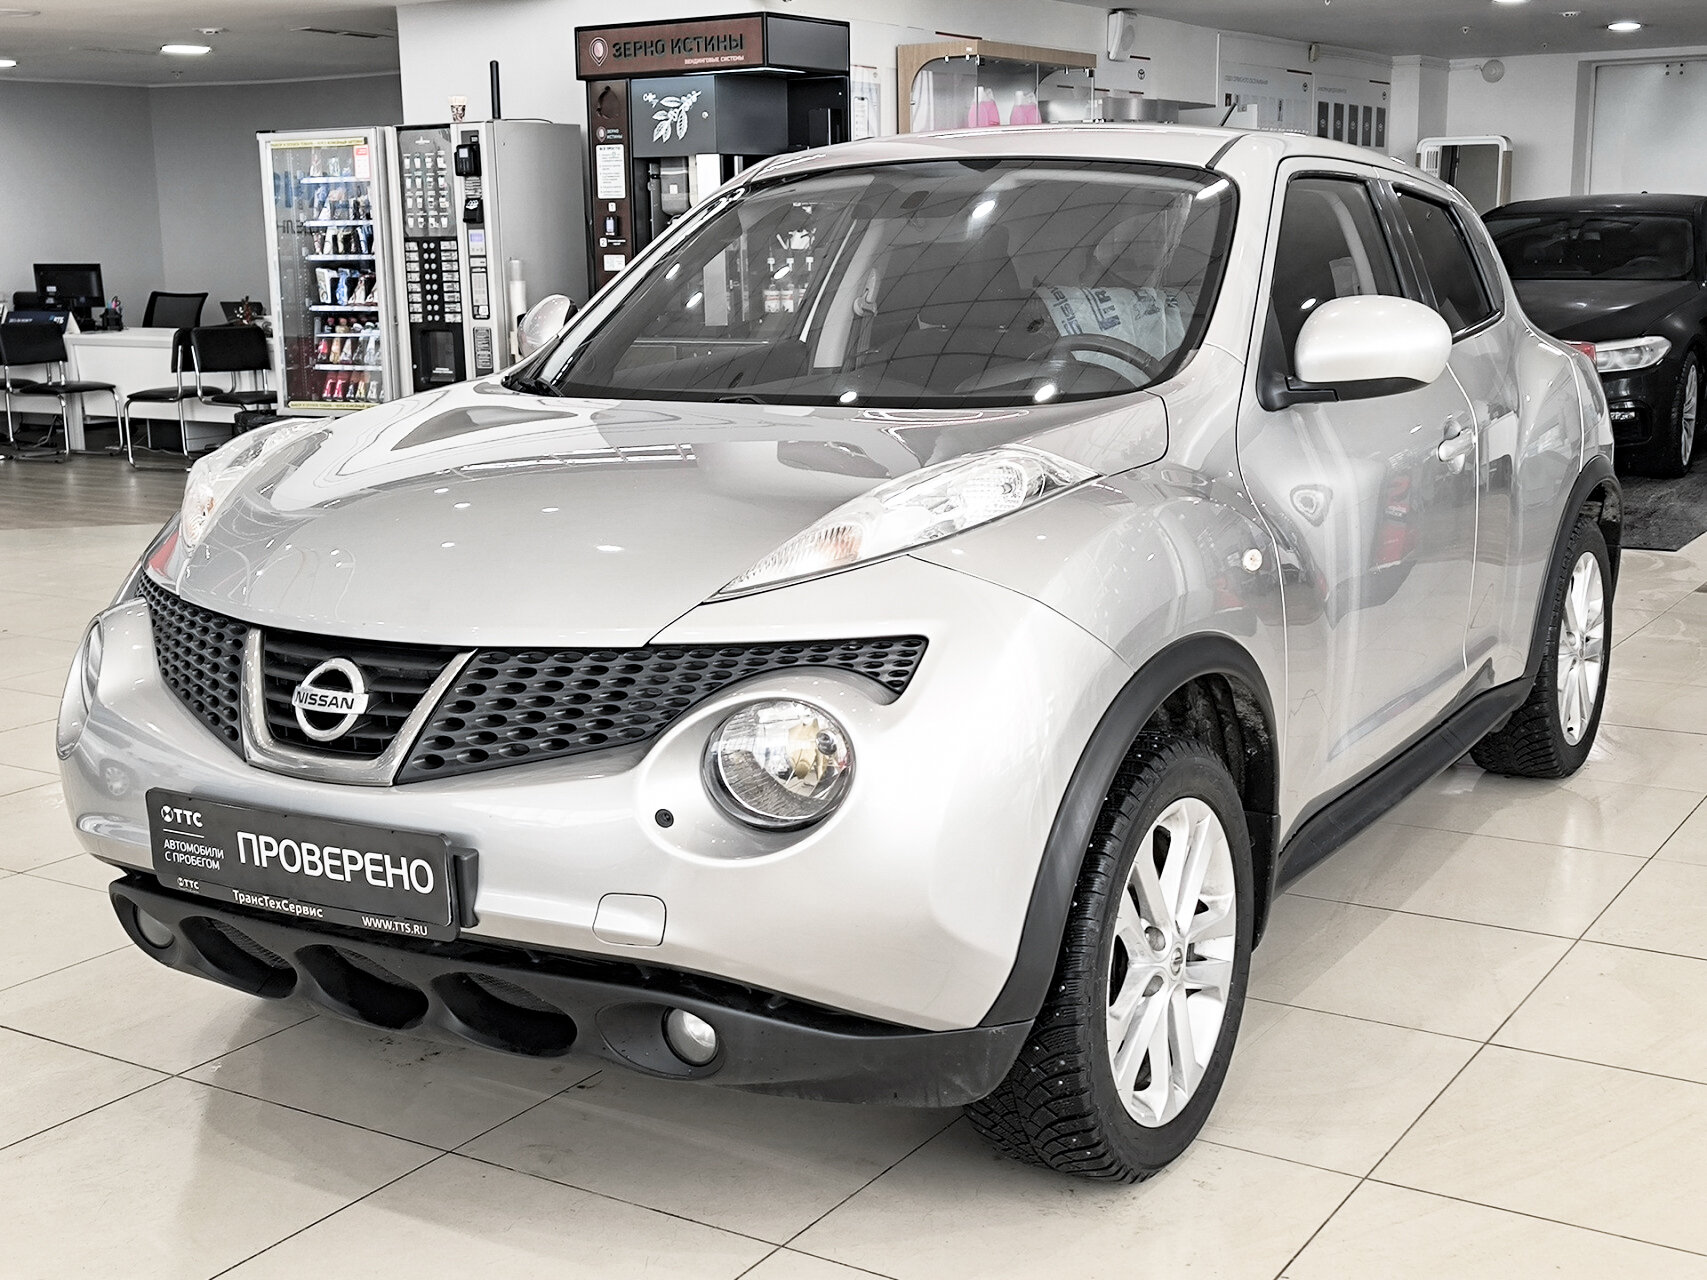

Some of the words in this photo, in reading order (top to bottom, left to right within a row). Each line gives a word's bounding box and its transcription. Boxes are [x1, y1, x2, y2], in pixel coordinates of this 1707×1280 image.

[612, 38, 666, 59] ЗЕРНО
[671, 33, 744, 55] ИСТИНЫ
[295, 691, 355, 710] NISSAN
[172, 808, 204, 828] ТТС
[163, 838, 225, 860] АВТОМОБИЛИ
[164, 850, 172, 862] С
[172, 851, 221, 871] ПРОБЕГОМ
[236, 831, 435, 895] ПРОВЕРЕНО
[183, 878, 200, 890] ТТС
[232, 889, 324, 919] ТрансТехСервис
[361, 915, 429, 936] WWW.TTS.RU
